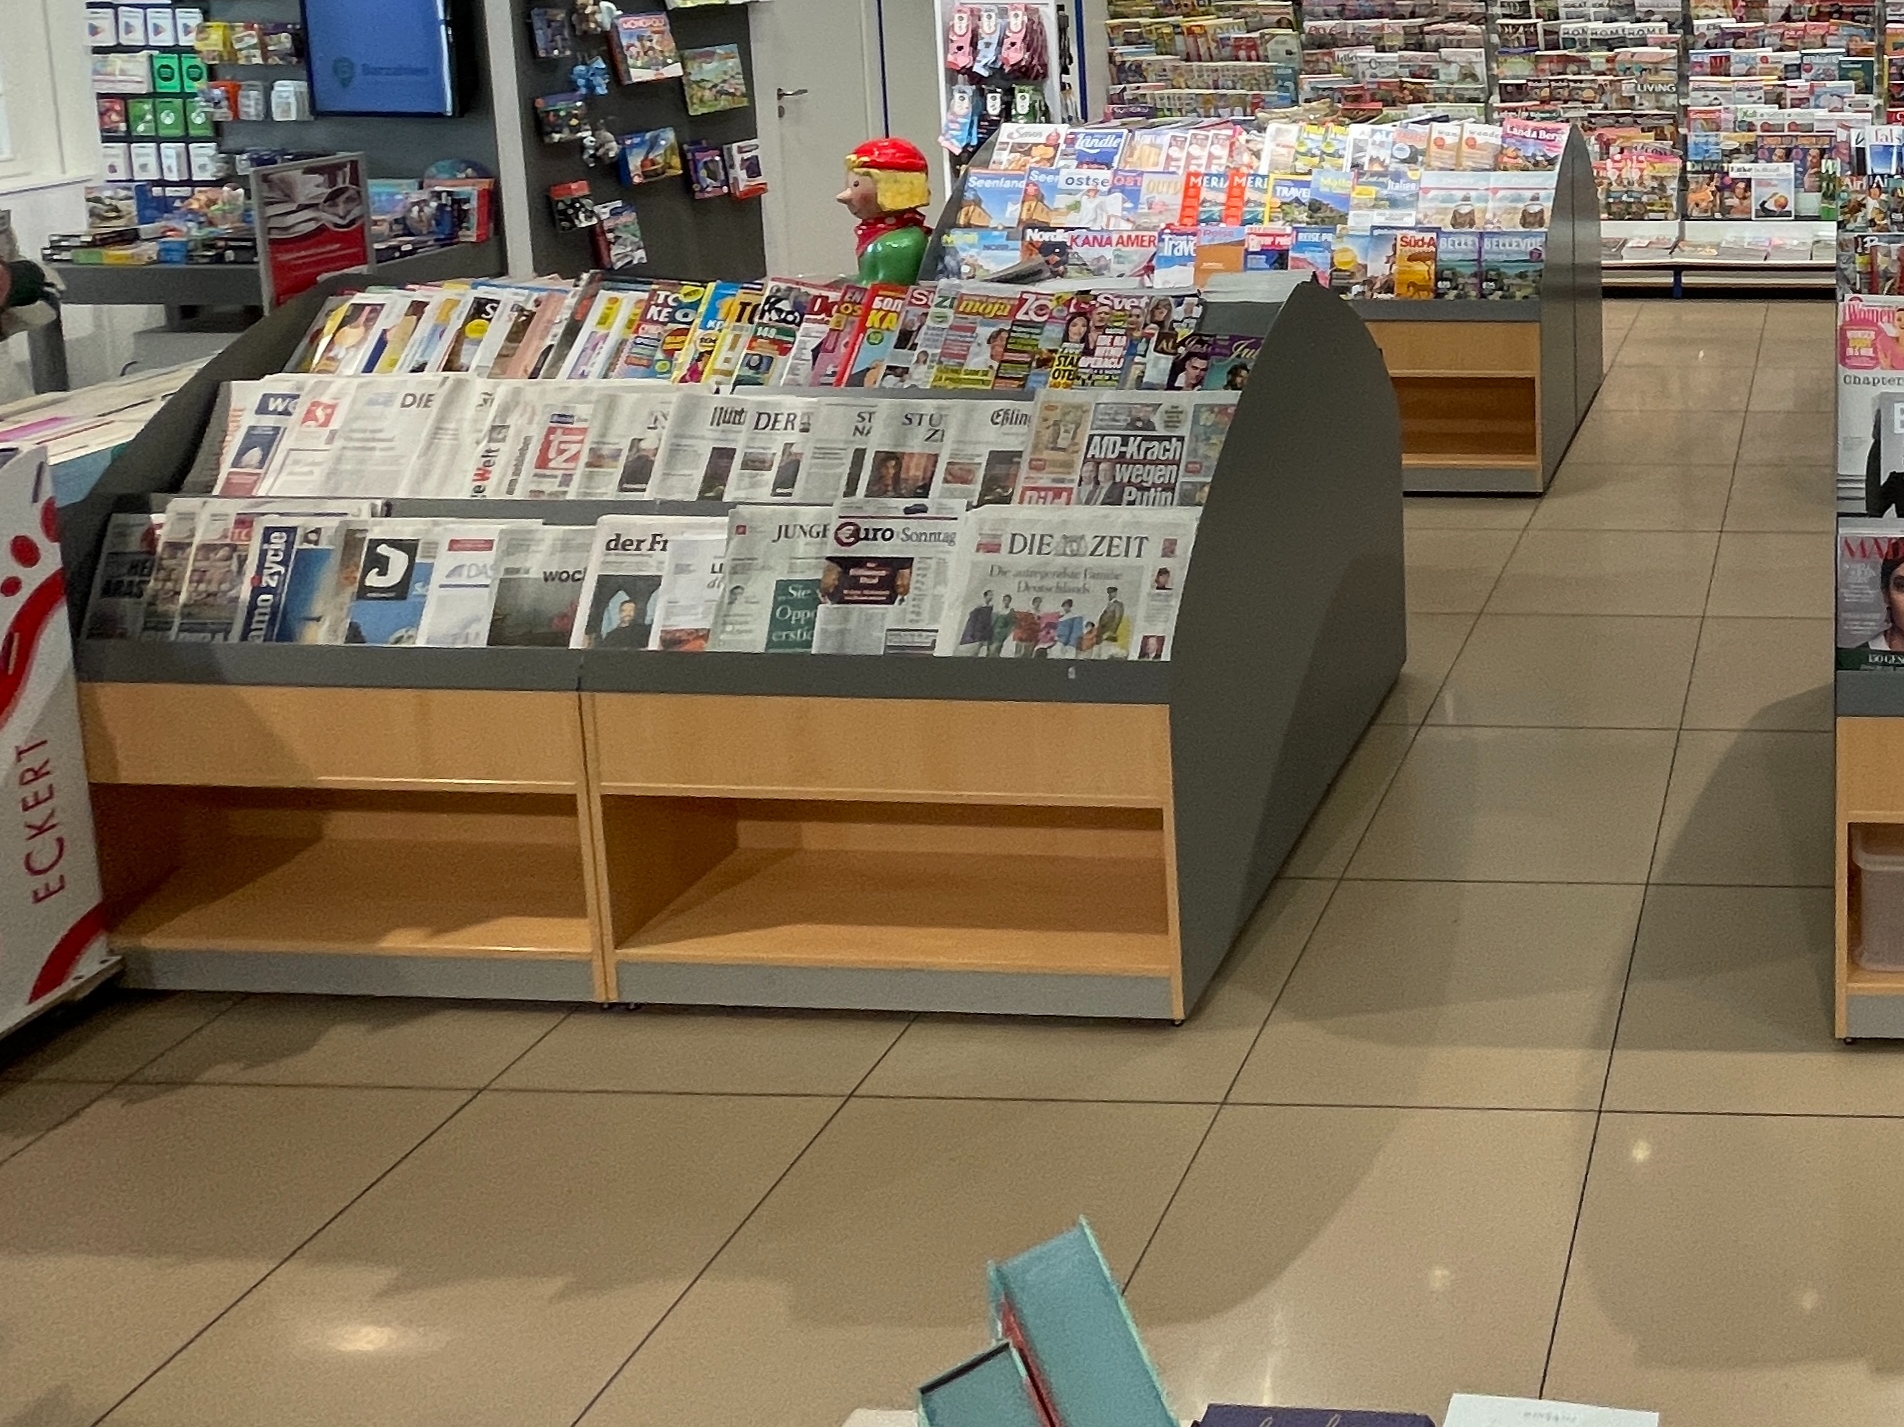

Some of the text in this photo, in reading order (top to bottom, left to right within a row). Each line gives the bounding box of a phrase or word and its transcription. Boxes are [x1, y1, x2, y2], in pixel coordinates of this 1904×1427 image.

[400, 392, 435, 409] DIE
[753, 412, 797, 432] DER
[1087, 436, 1183, 461] AfD-Krach
[1115, 462, 1177, 485] wegen
[605, 534, 642, 552] der
[1008, 532, 1149, 559] DIE ZEIT
[16, 739, 66, 904] ECKERT
